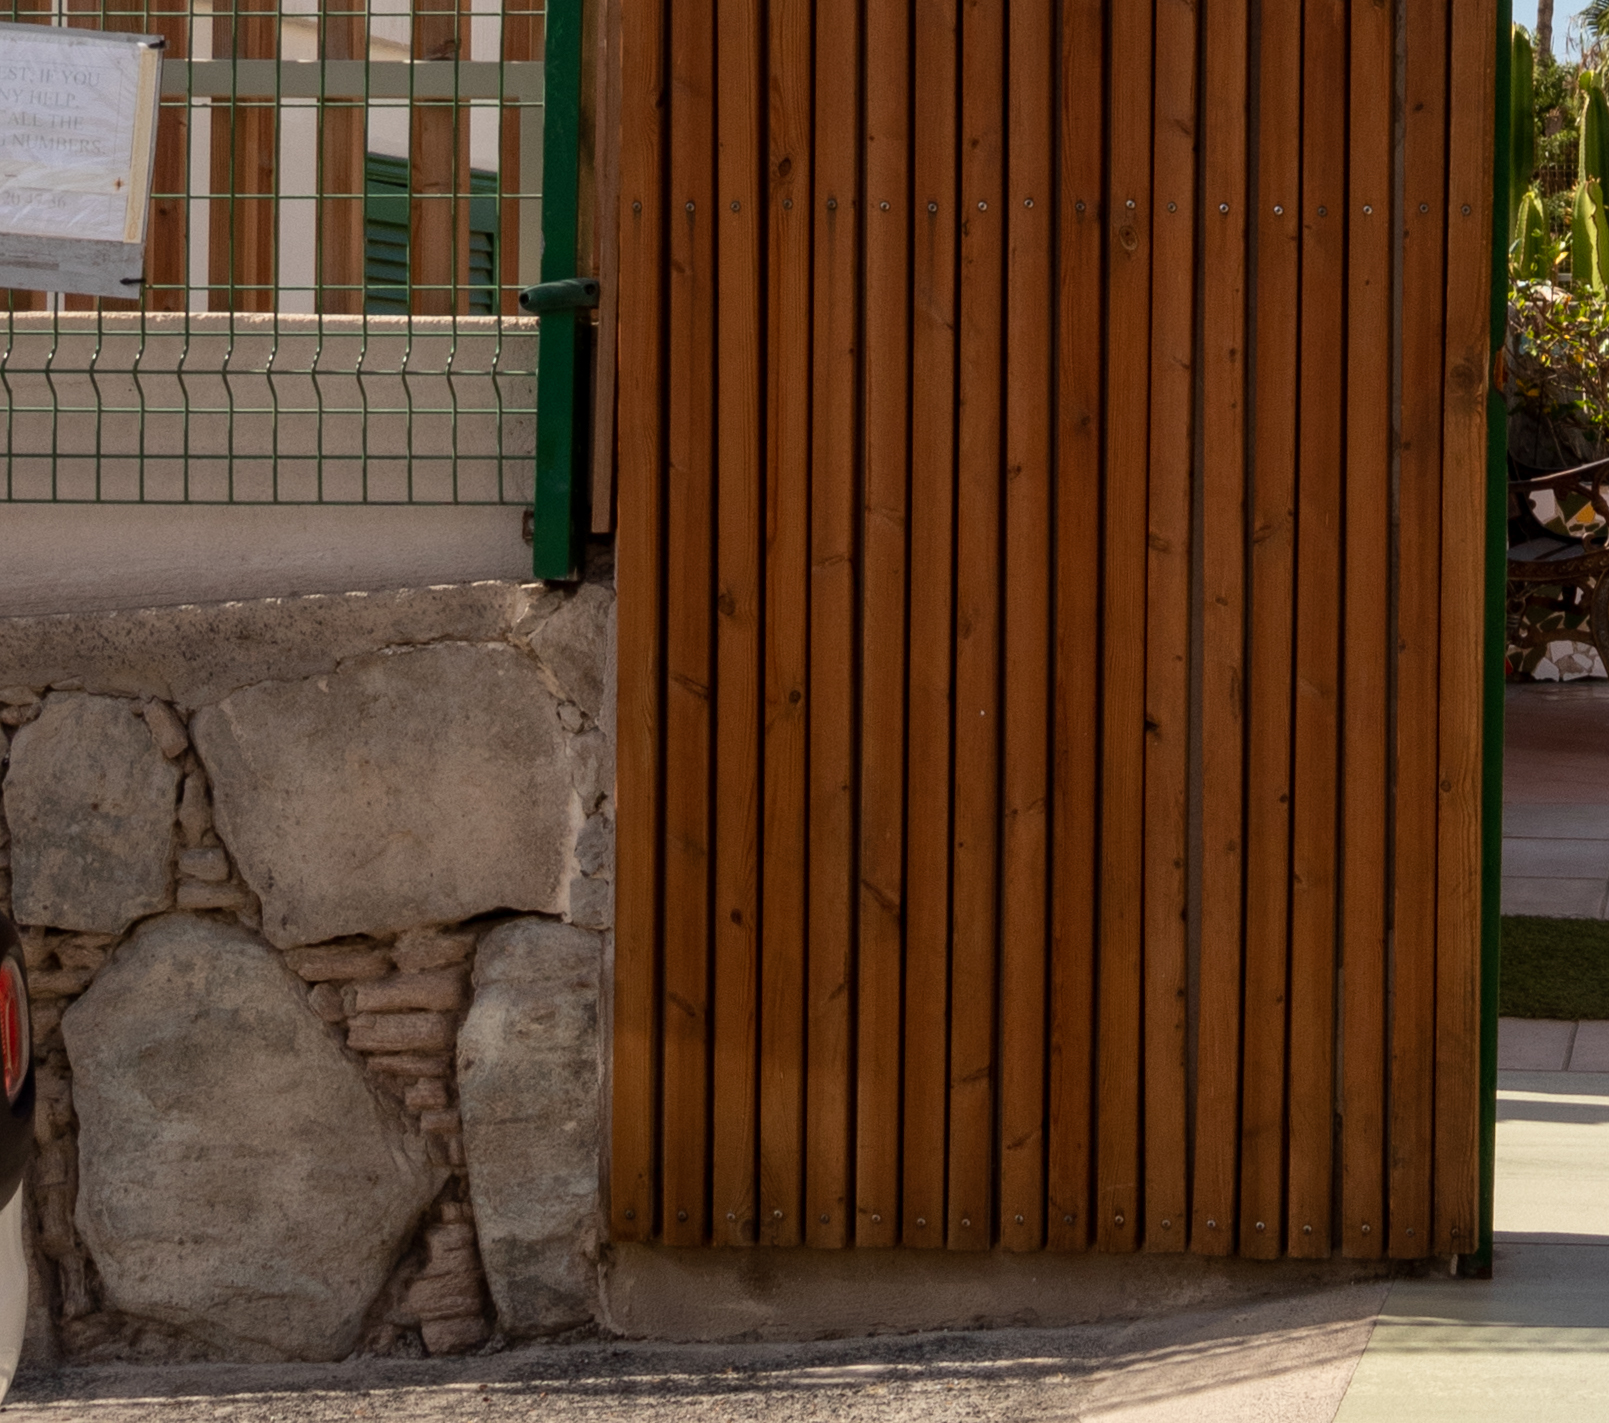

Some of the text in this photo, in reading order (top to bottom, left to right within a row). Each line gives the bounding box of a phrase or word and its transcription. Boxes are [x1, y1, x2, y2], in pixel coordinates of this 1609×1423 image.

[40, 68, 54, 83] IF
[62, 70, 100, 87] YOU
[49, 114, 84, 129] THE
[12, 133, 106, 155] NUMBERS.
